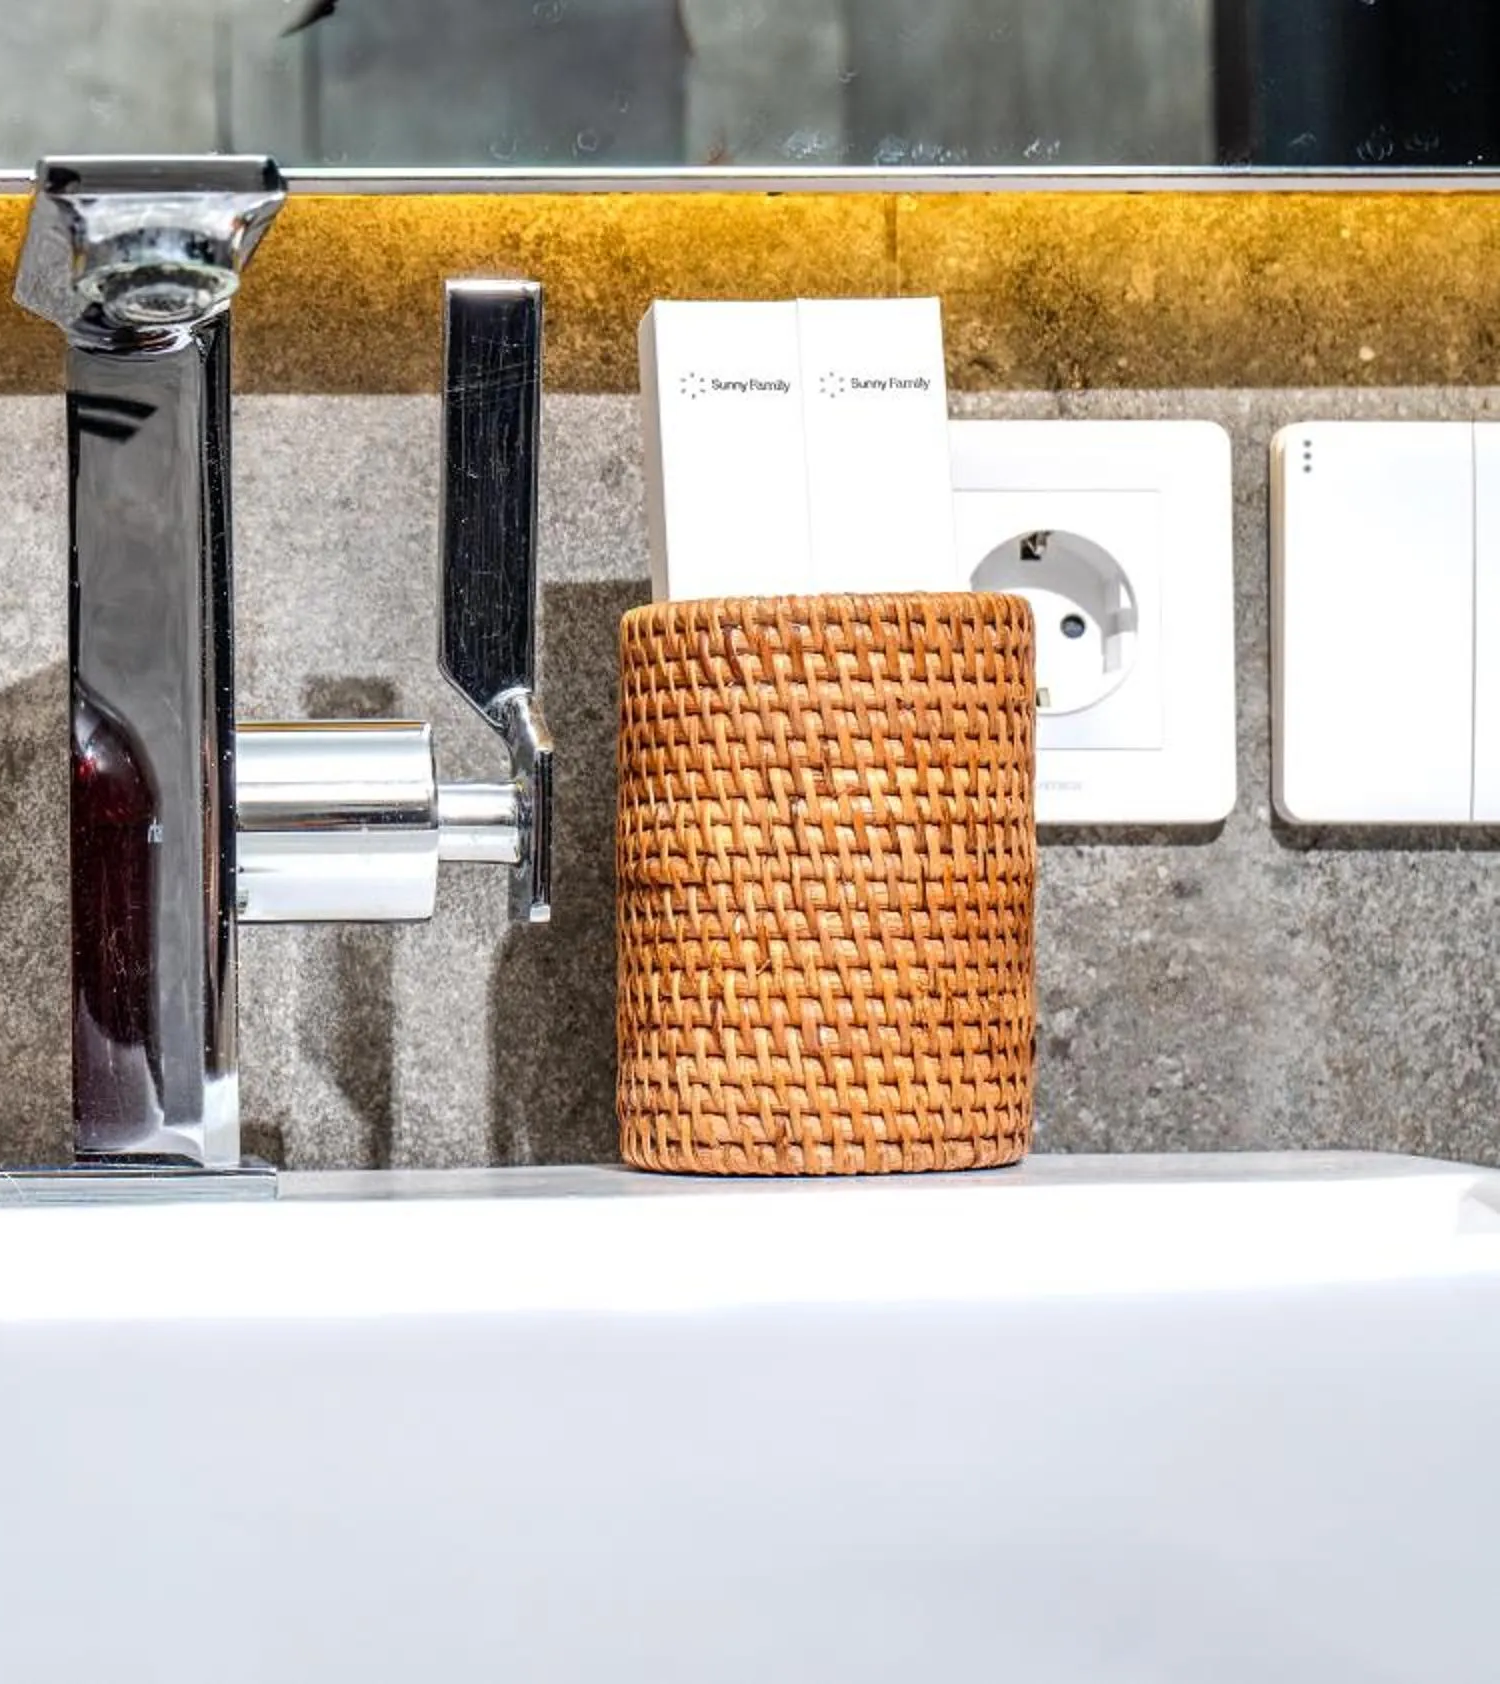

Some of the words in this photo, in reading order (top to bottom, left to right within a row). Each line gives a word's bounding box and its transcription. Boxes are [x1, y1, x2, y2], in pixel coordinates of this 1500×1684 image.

[711, 379, 748, 393] Sunny
[749, 378, 790, 394] Family
[851, 377, 886, 391] Sunny
[889, 377, 930, 391] Family
